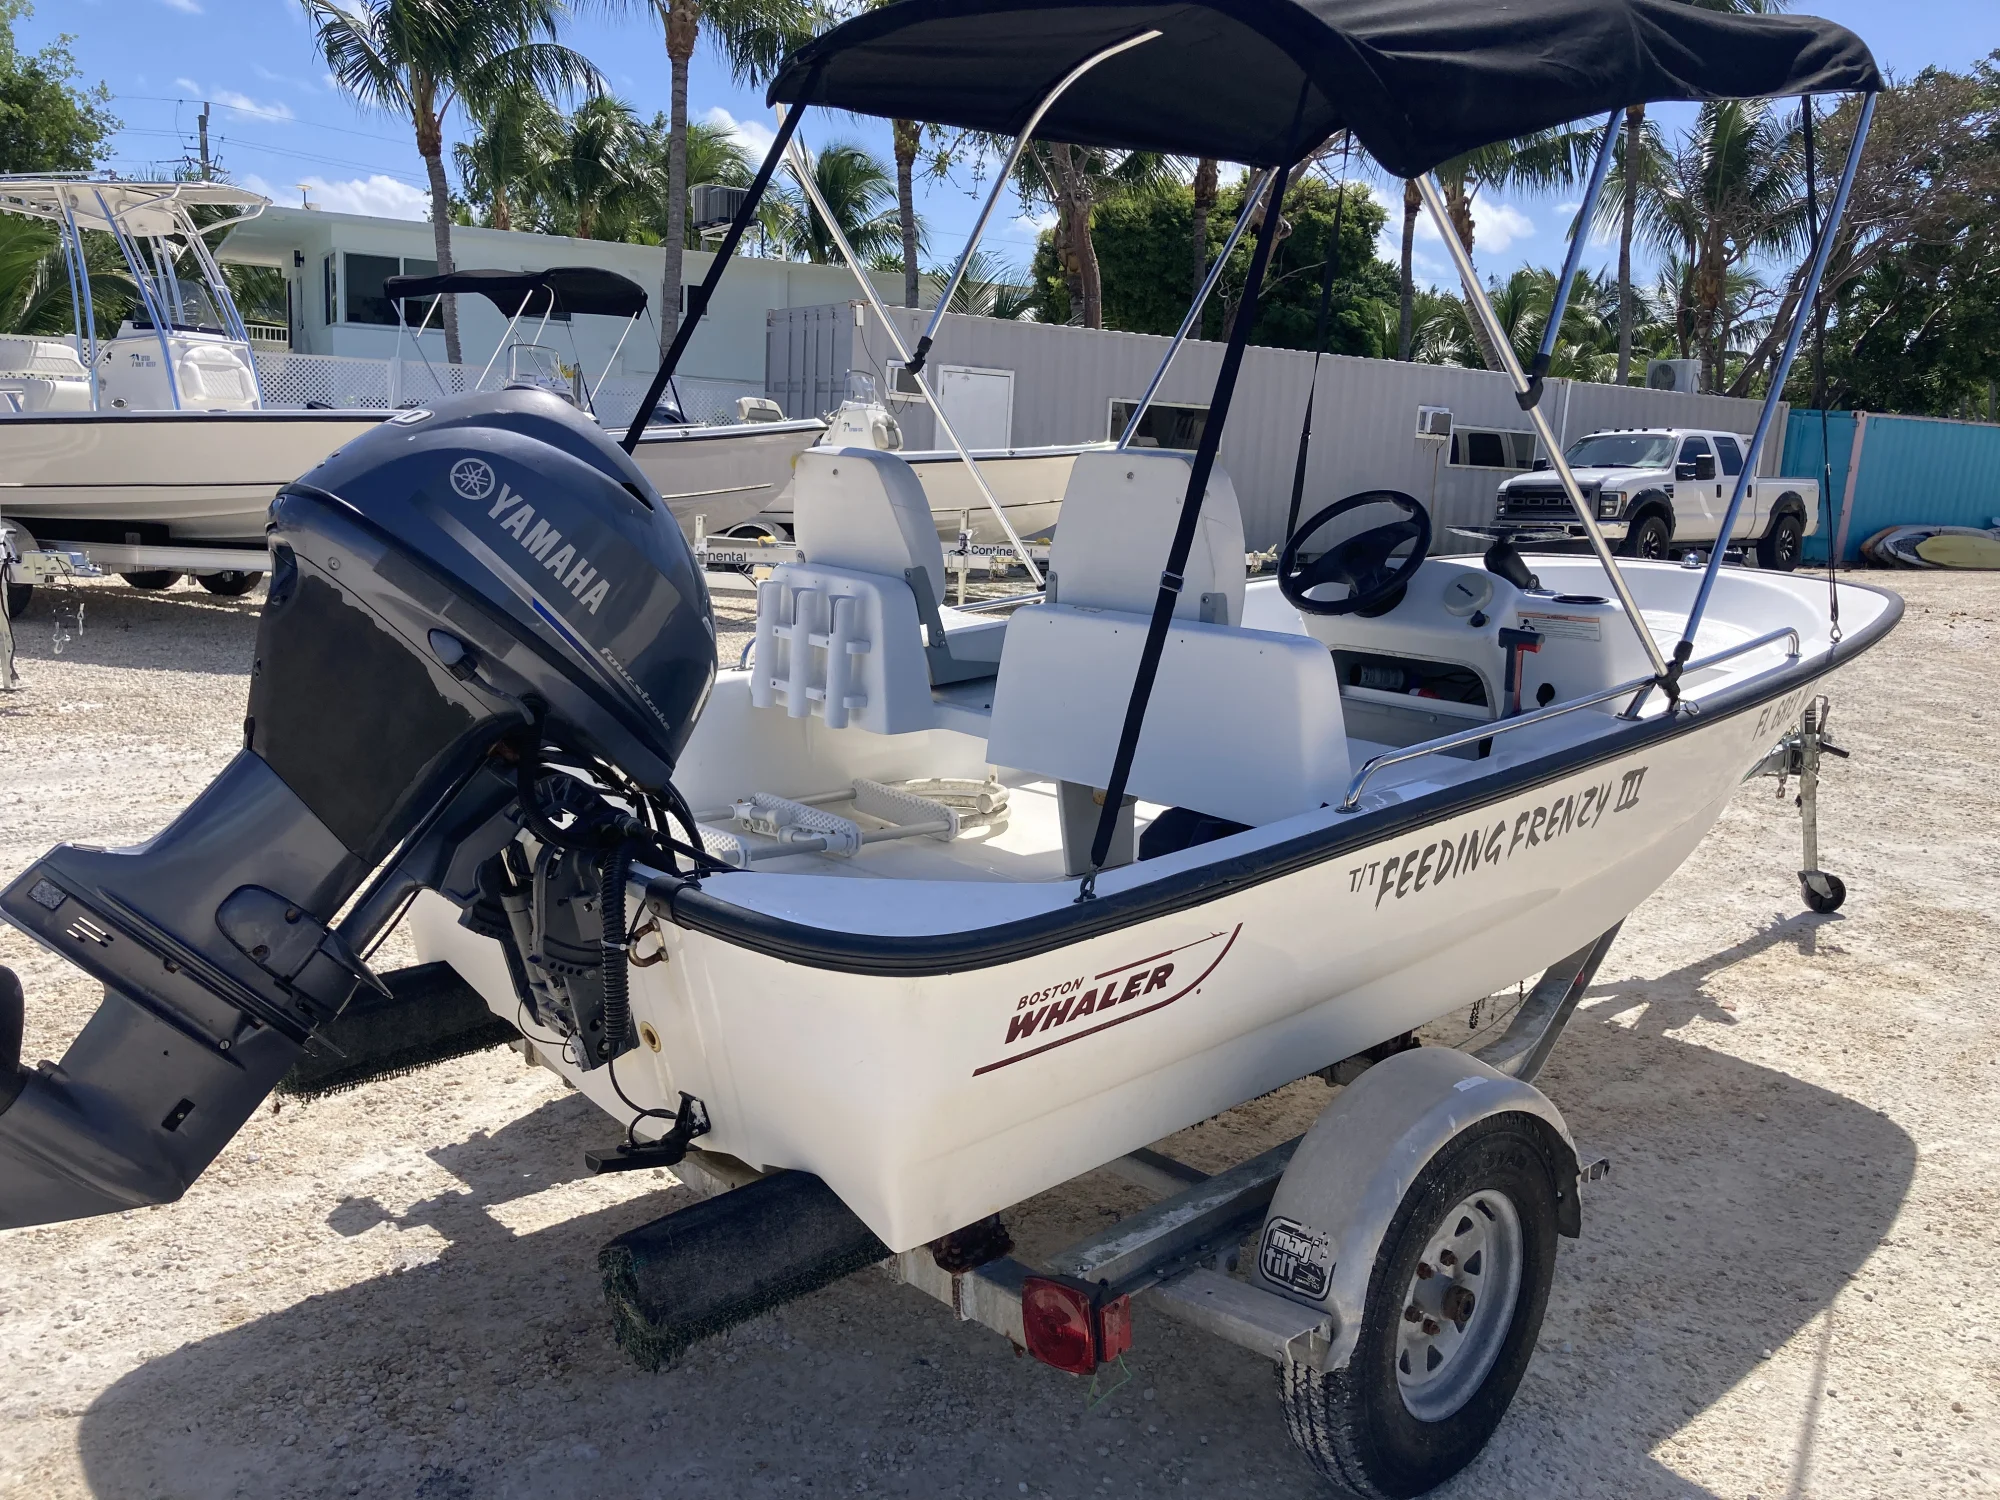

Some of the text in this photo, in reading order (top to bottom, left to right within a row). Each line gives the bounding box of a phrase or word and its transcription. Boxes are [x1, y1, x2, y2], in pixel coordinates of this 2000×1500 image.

[487, 482, 611, 616] YAMAHA
[707, 551, 747, 562] nental
[971, 545, 1033, 558] Continenl
[1751, 704, 1773, 742] FL
[1349, 765, 1650, 911] T/T FEEDING FRENZY III
[1004, 962, 1176, 1045] WHALER
[1016, 976, 1086, 1012] BOSTON
[1265, 1247, 1299, 1281] tilt
